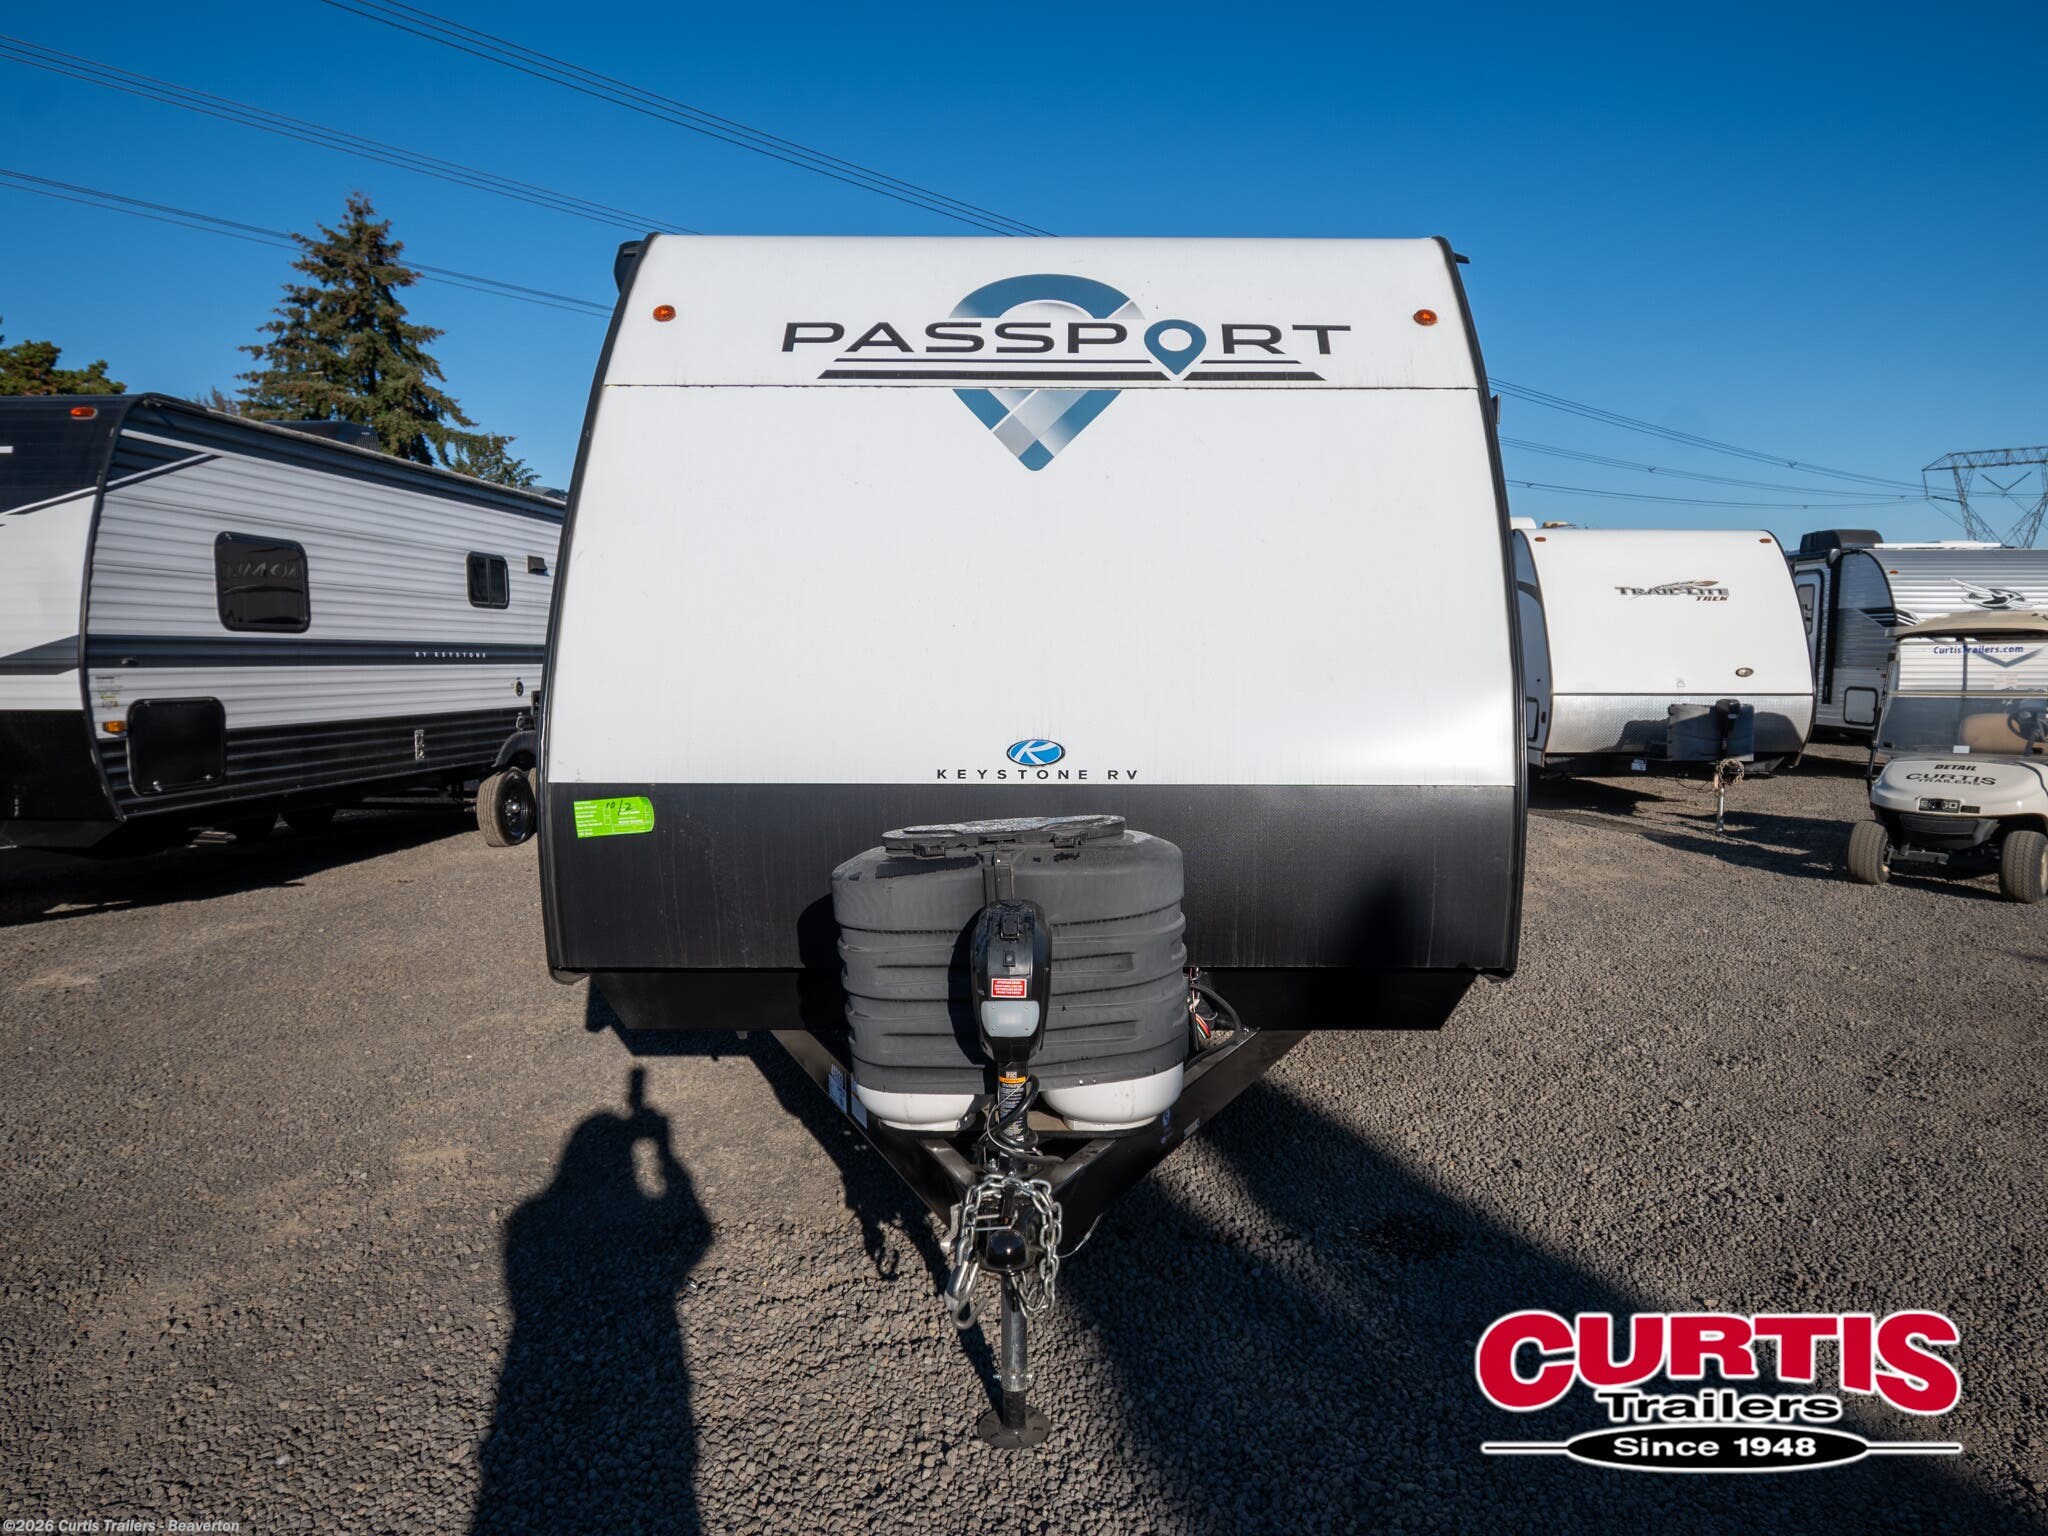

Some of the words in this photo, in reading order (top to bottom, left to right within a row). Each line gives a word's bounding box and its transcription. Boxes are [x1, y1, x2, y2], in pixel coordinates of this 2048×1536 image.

[781, 319, 1351, 375] PASSPORT
[1933, 645, 2024, 654] CurtisTrailers.com
[936, 769, 1088, 780] KEYSTONE
[1107, 769, 1138, 780] RV
[1906, 773, 1997, 786] CURTIS
